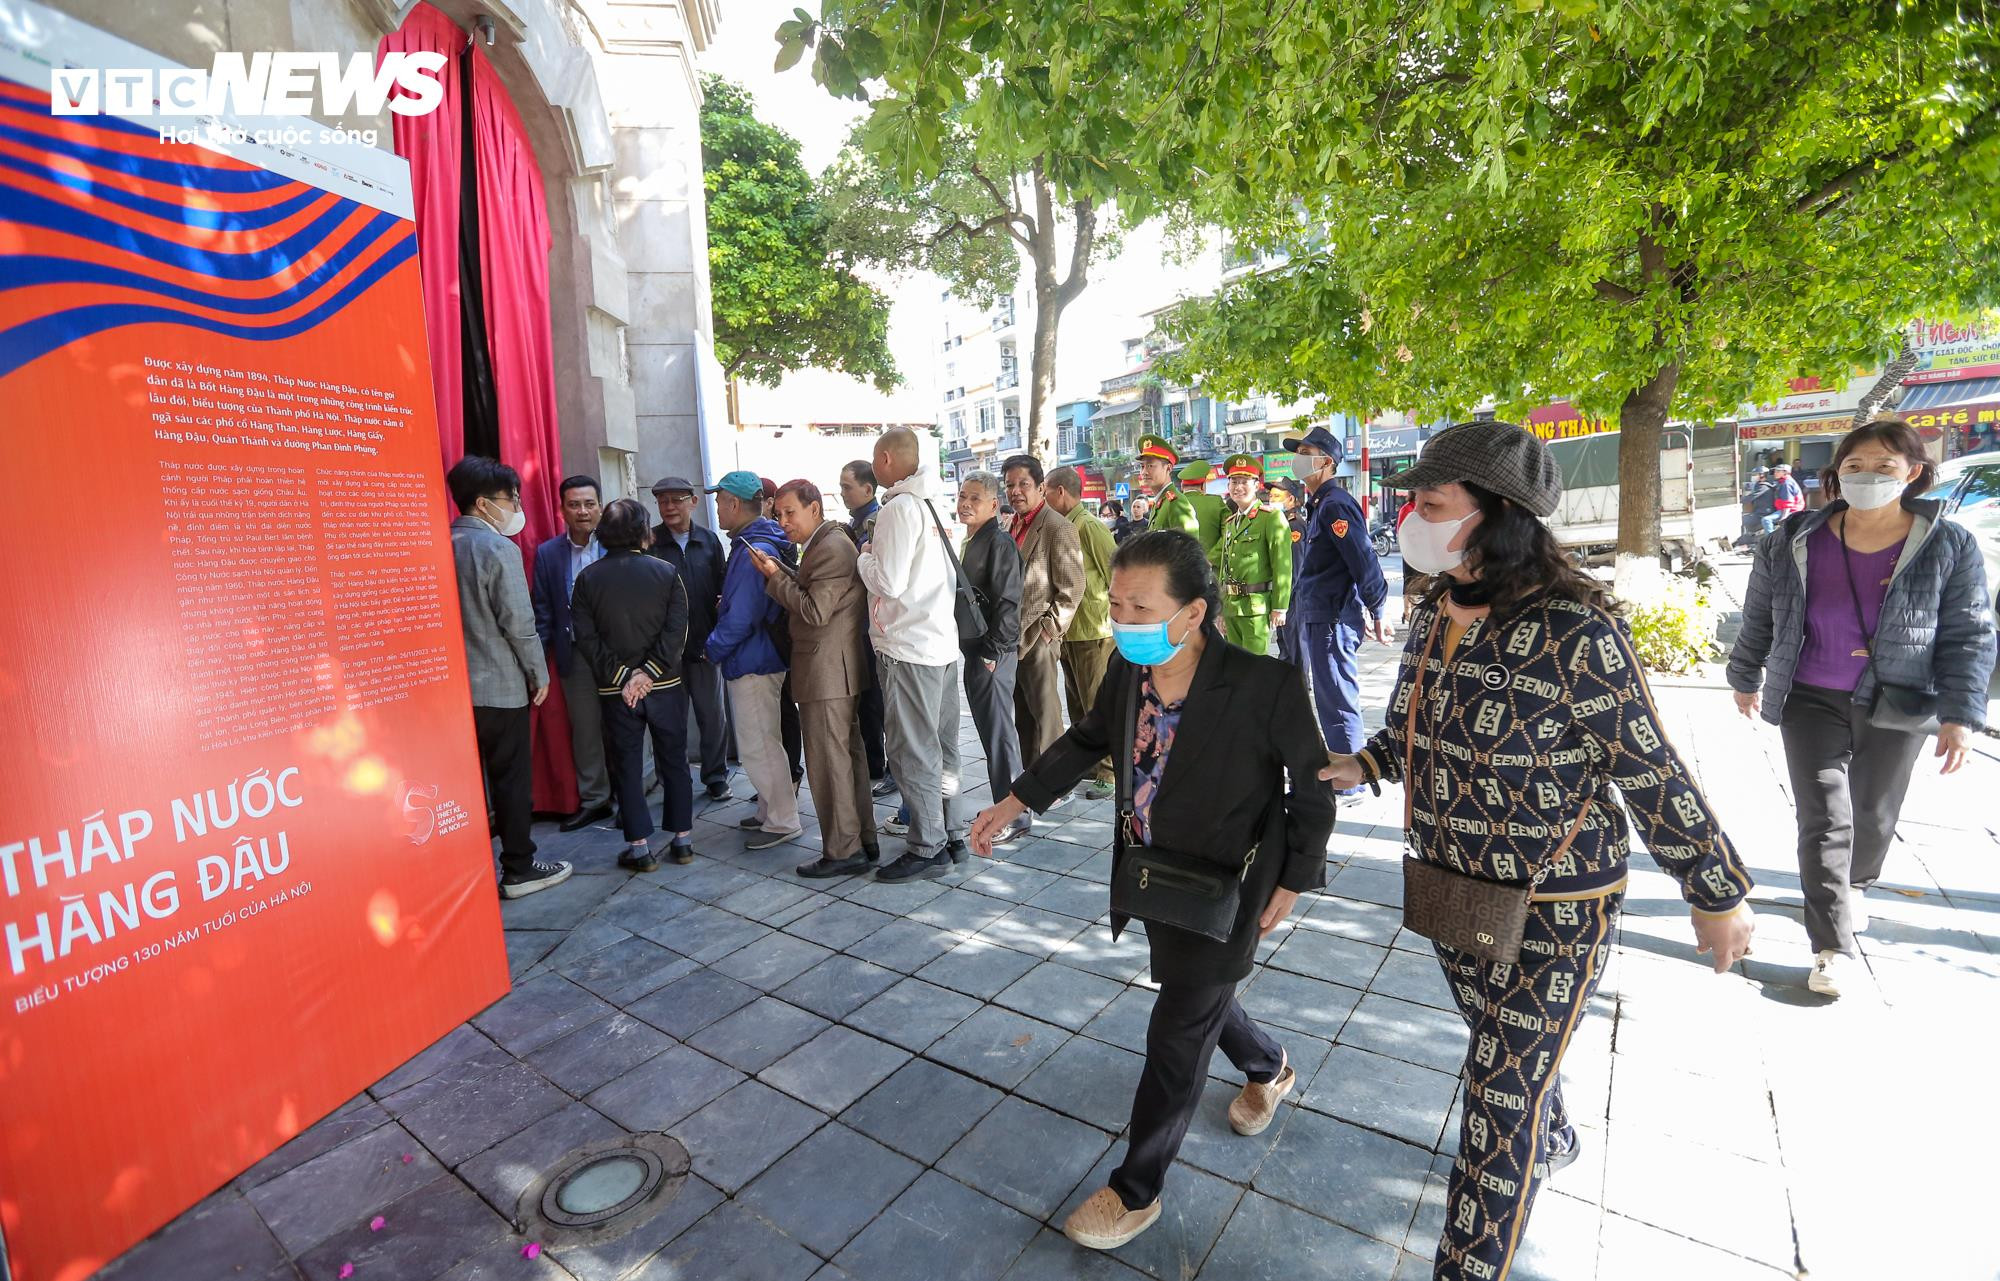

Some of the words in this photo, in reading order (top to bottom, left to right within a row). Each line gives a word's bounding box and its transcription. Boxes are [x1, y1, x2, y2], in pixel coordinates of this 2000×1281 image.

[144, 356, 172, 370] Được
[175, 360, 193, 374] xây
[196, 363, 222, 378] dựng
[223, 368, 244, 379] năm
[246, 371, 271, 383] 1894,
[272, 374, 295, 387] Tháp
[296, 378, 318, 388] Nước
[146, 373, 167, 386] dân
[170, 377, 184, 388] dã
[186, 378, 196, 389] là
[199, 381, 216, 392] Bốt
[219, 384, 244, 398] Hàng
[246, 387, 264, 398] Đậu
[266, 389, 275, 398] là
[277, 391, 294, 402] một
[296, 394, 319, 406] trong
[149, 391, 166, 403] lâu
[169, 394, 189, 408] đời,
[192, 396, 214, 408] biểu
[216, 400, 245, 414] tượng
[246, 403, 263, 413] của
[265, 405, 292, 416] Thành
[294, 408, 310, 419] phố
[152, 411, 172, 424] ngã
[174, 413, 193, 423] sáu
[195, 415, 212, 425] các
[215, 417, 234, 428] phố
[236, 418, 247, 428] cổ
[250, 420, 274, 433] Hàng
[274, 422, 299, 434] Than,
[154, 429, 183, 443] Hàng
[185, 431, 209, 443] Đậu,
[211, 433, 238, 445] Quán
[240, 435, 269, 446] Thánh
[271, 438, 281, 447] và
[283, 438, 310, 451] đường
[1514, 675, 1561, 700] EENDI
[1571, 693, 1617, 719] EENDI
[1441, 738, 1472, 761] EENDI
[1492, 754, 1533, 768] EENDI
[0, 810, 153, 897] THÁP
[171, 767, 303, 842] NƯỚC
[1450, 817, 1488, 836] EENDI
[1508, 822, 1548, 839] EENDI
[5, 872, 181, 975] HÀNG
[196, 832, 291, 902] ĐẬU
[15, 985, 59, 1014] BIỂU
[63, 956, 130, 993] TƯỢNG
[133, 943, 161, 965] 130
[164, 927, 200, 951] NĂM
[201, 911, 238, 938] TUỔI
[238, 899, 269, 919] CỦA
[270, 890, 289, 909] HÀ
[290, 881, 313, 902] NỘI
[1500, 1007, 1543, 1031] EENDI
[1485, 1089, 1525, 1111] EENDI
